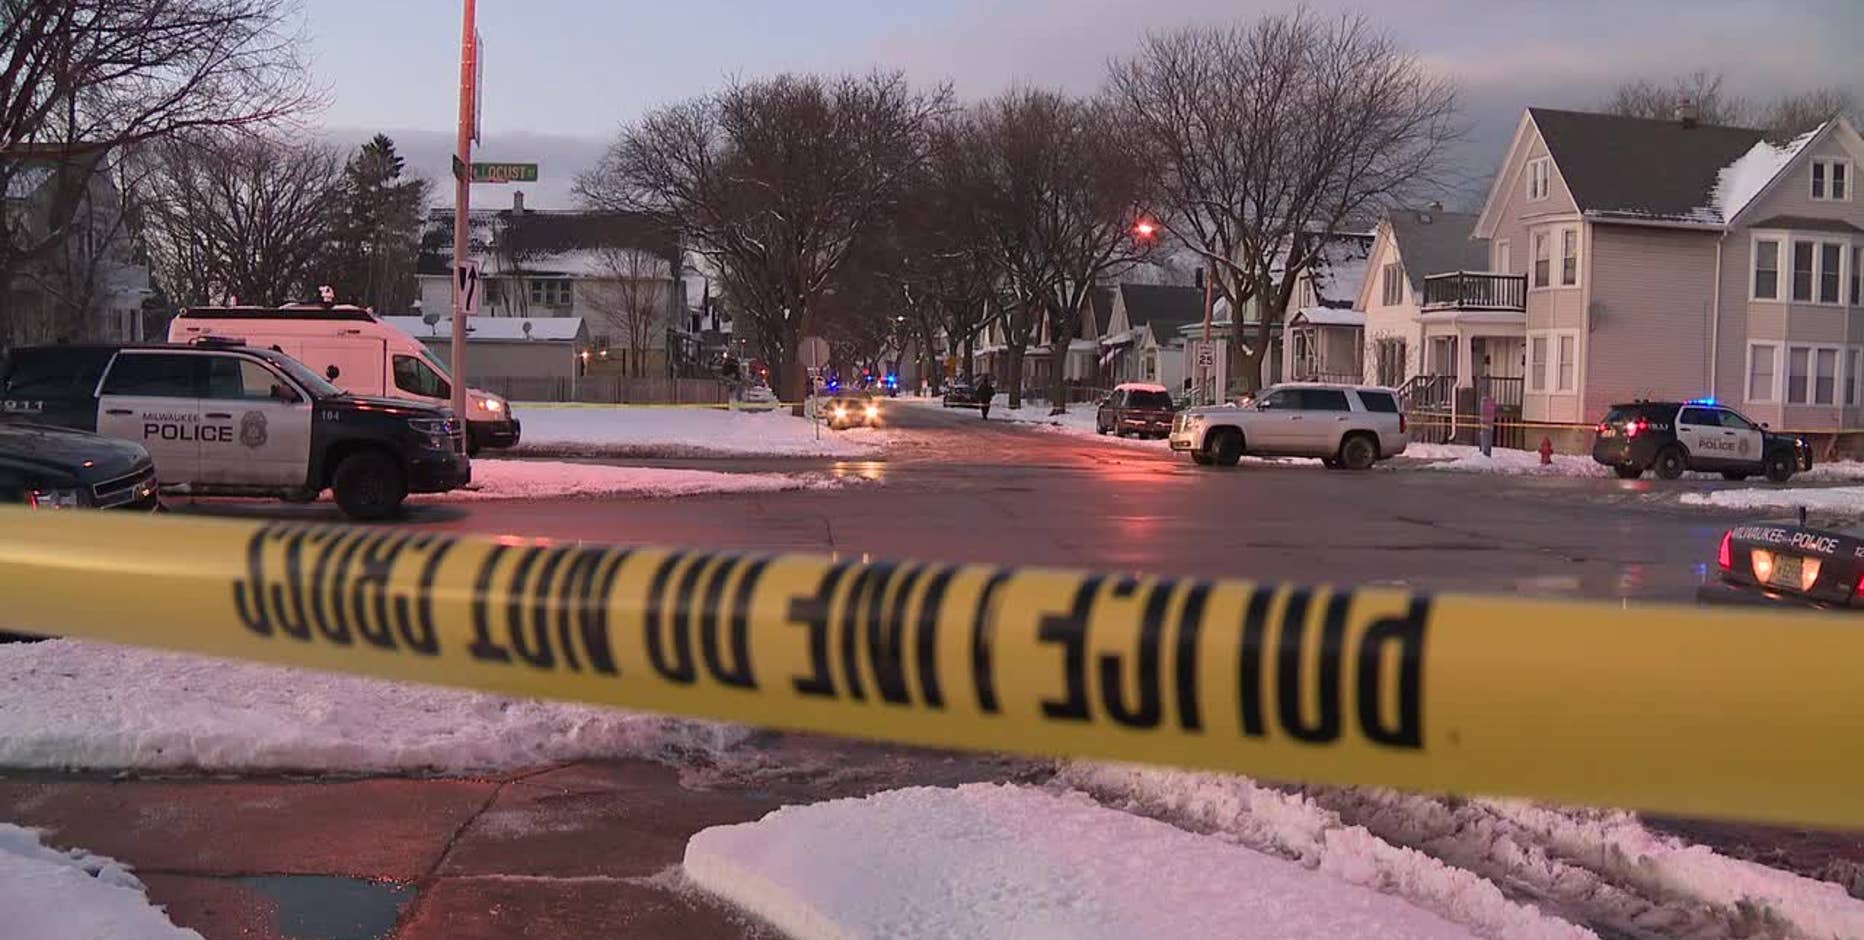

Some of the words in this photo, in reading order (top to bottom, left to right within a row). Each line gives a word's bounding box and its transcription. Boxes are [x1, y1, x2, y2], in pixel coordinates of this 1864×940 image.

[482, 166, 526, 180] LOCUST
[1200, 355, 1213, 365] 25
[142, 412, 201, 422] MILWAUKEE
[144, 424, 233, 442] POLICE
[1699, 440, 1735, 451] POLICE
[1791, 532, 1839, 554] POLICE
[468, 545, 632, 676] NOT
[645, 549, 771, 690] DO
